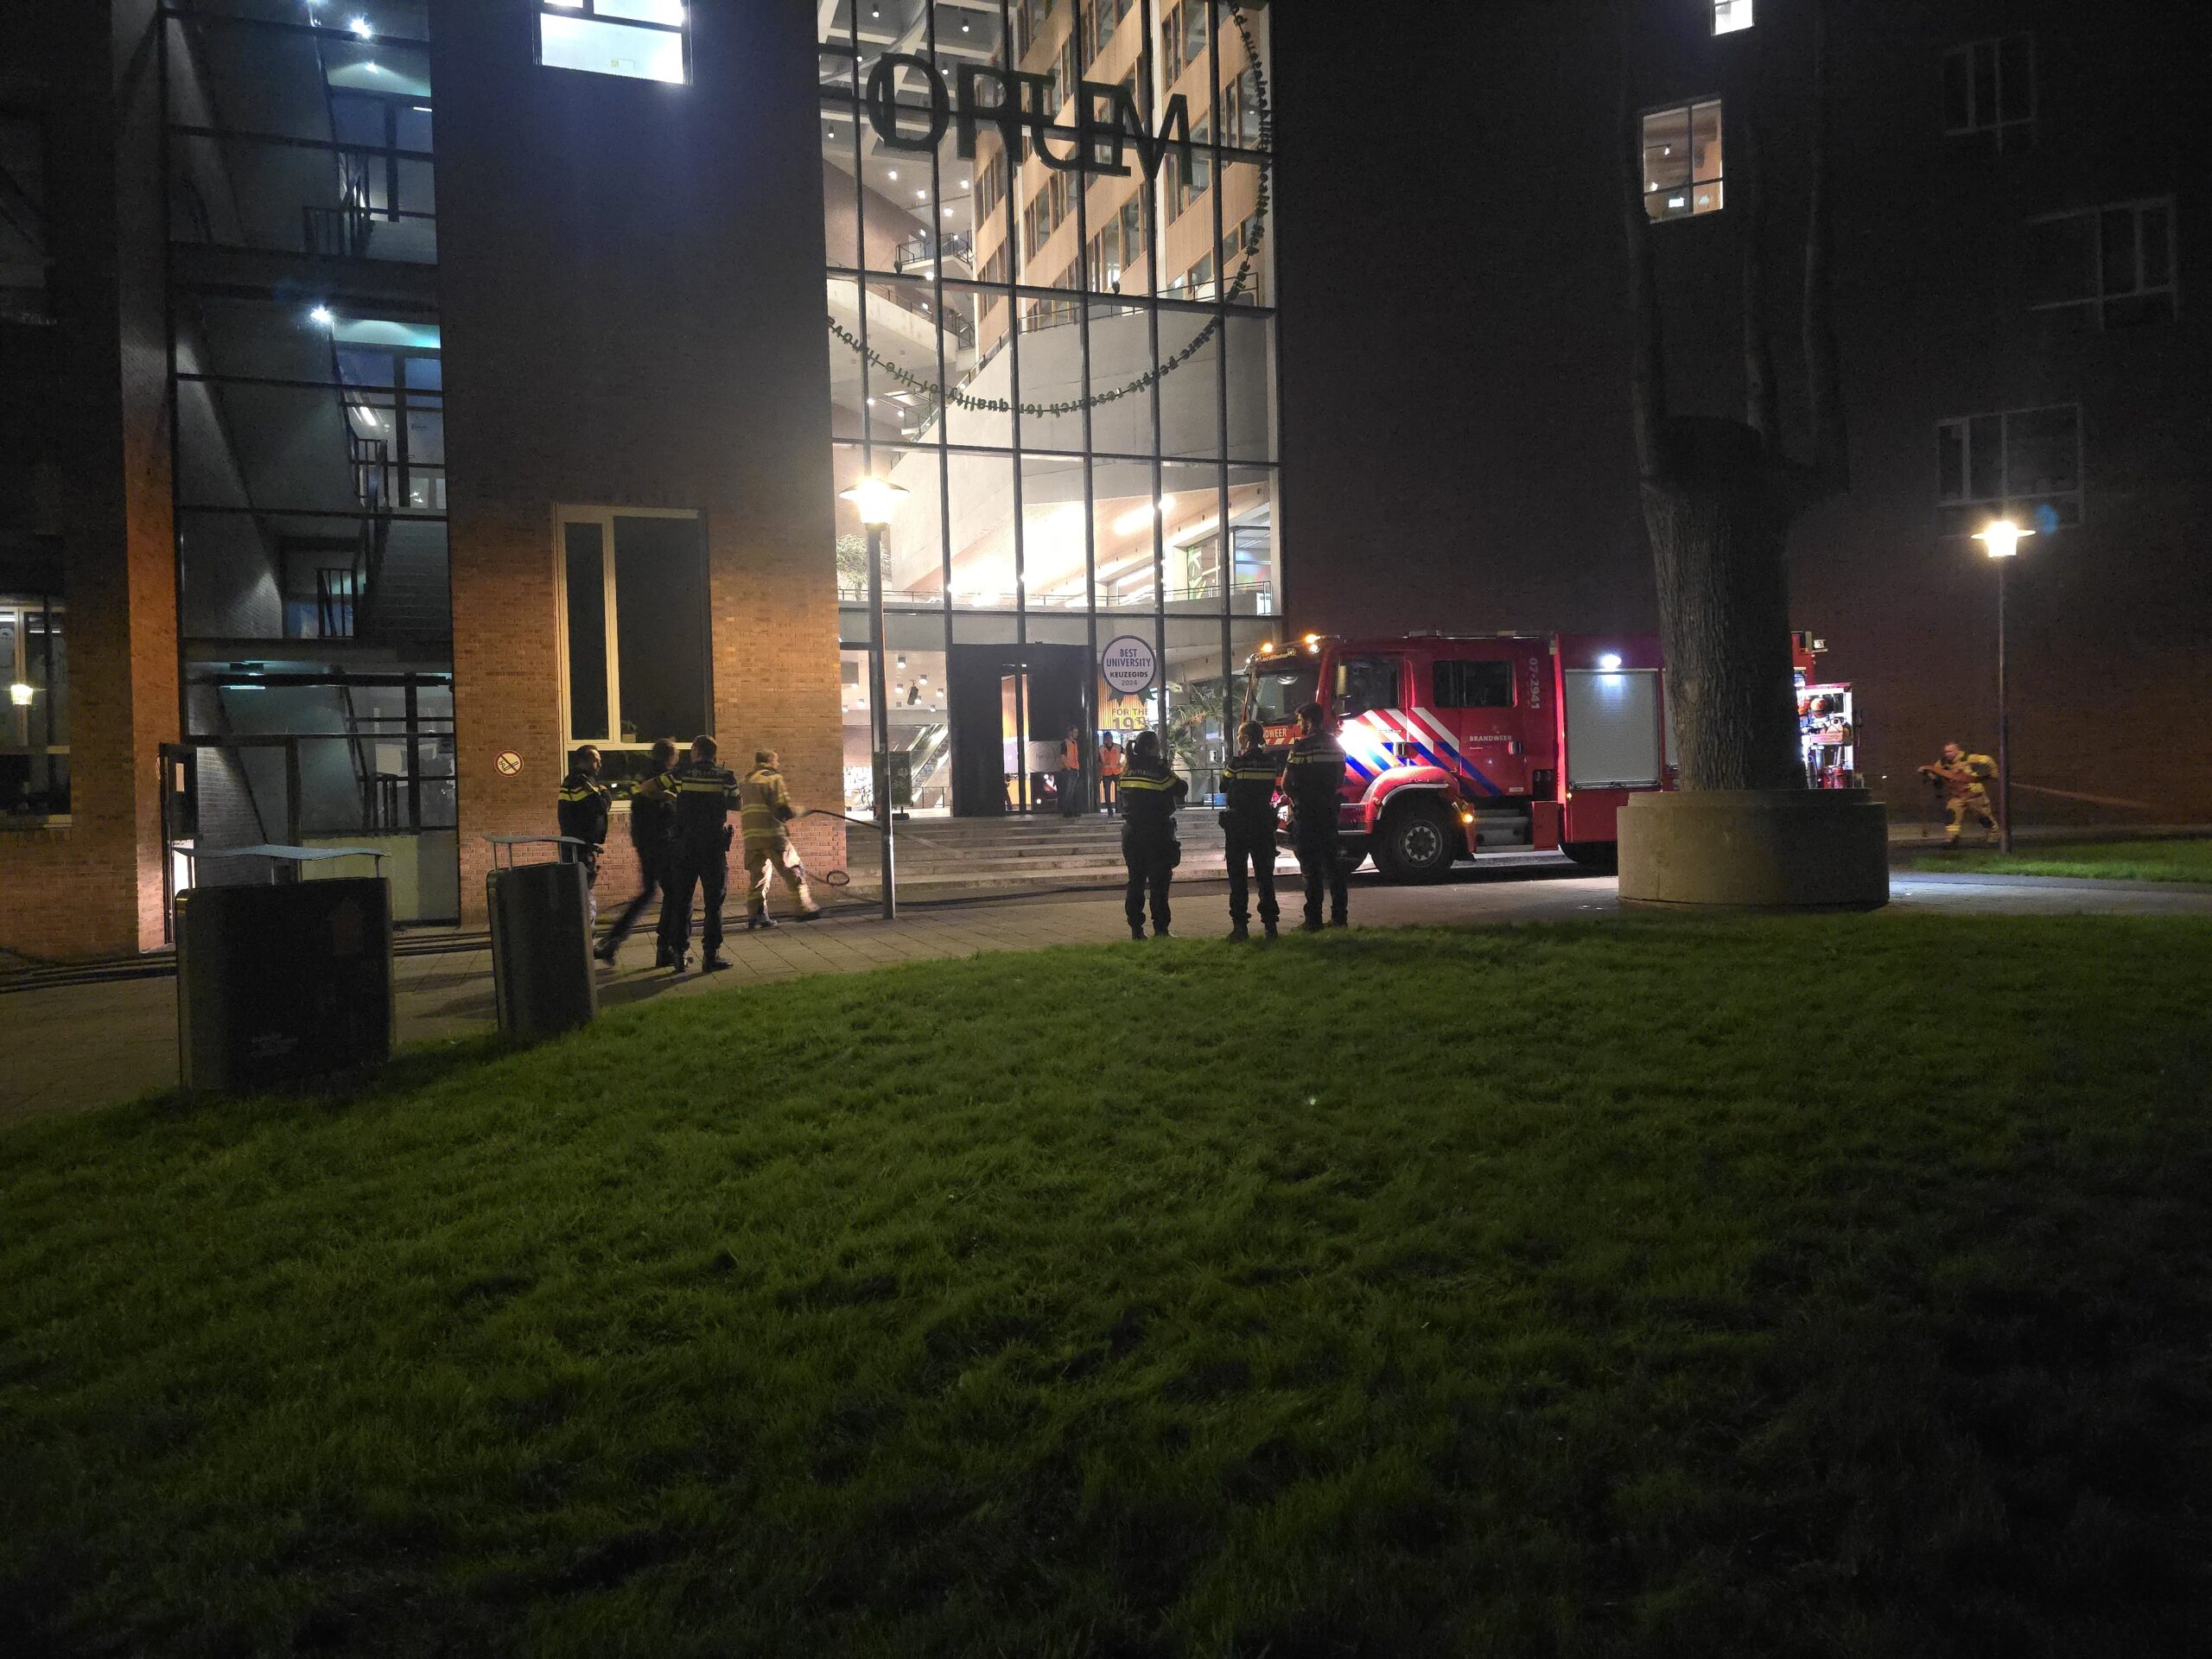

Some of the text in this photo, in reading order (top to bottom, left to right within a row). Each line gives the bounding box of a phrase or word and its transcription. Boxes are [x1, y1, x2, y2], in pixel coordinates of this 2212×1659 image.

[885, 361, 914, 387] life
[946, 387, 1009, 412] quality
[1019, 404, 1043, 418] for
[1106, 658, 1151, 667] UNIVERSITY
[1120, 649, 1138, 658] BEST
[1529, 657, 1541, 709] 07-2941
